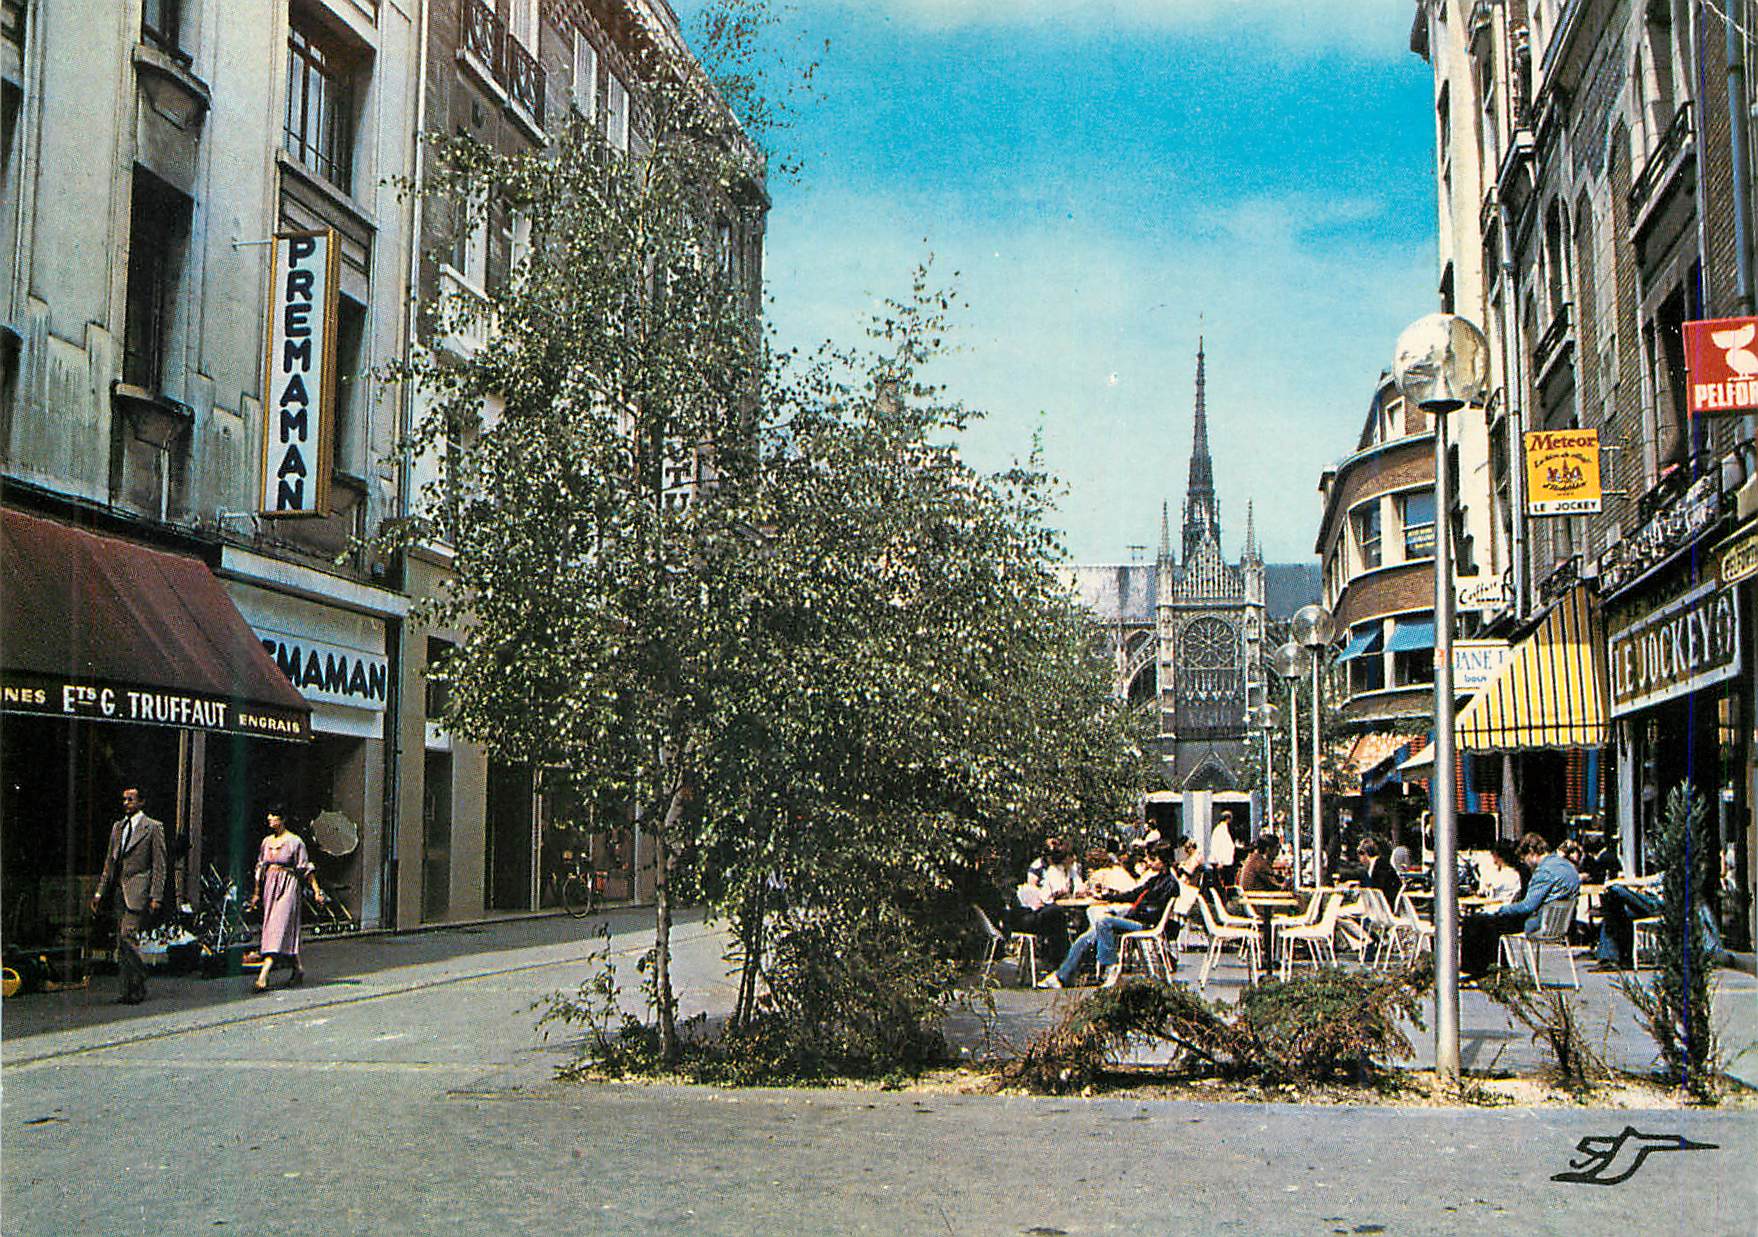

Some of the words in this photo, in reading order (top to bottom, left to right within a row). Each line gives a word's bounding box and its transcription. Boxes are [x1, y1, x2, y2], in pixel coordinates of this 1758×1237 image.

[276, 237, 317, 511] PREMAMAN
[1529, 433, 1597, 451] Meteor
[1533, 503, 1546, 512] LE
[1555, 501, 1597, 511] JOCKEY
[1615, 643, 1634, 696] LE
[1637, 602, 1713, 689] JOCKEY
[127, 691, 228, 728] TRUFFAUT
[238, 713, 301, 734] ENGRAIS
